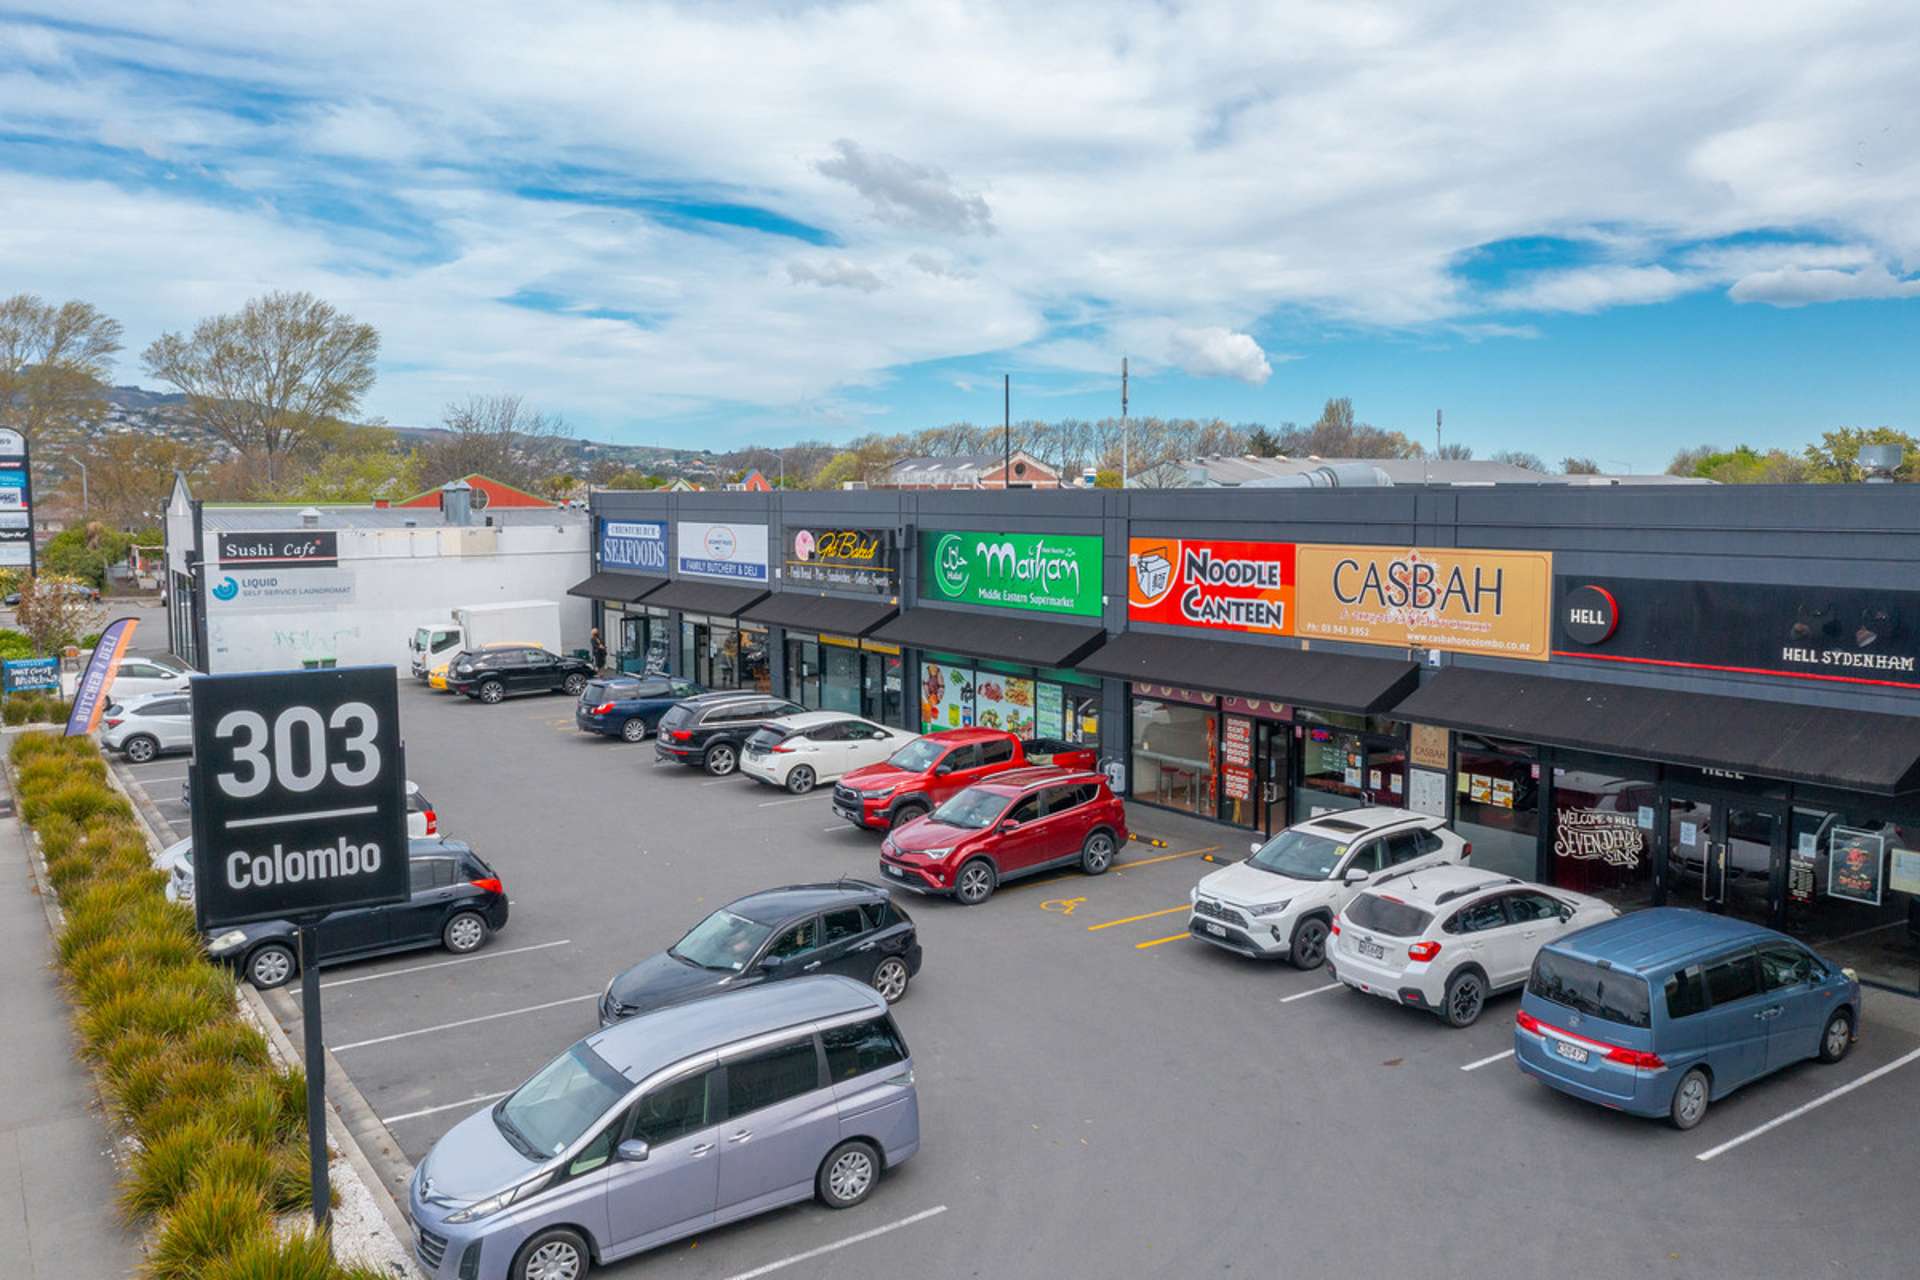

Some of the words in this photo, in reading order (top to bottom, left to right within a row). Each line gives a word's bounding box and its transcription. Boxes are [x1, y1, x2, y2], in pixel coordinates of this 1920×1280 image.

[226, 543, 275, 557] Sushi
[604, 539, 665, 567] SEAFOODS
[839, 531, 879, 560] Baked
[707, 561, 736, 574] BUTCHERY
[738, 563, 744, 575] &
[744, 564, 758, 577] DELI
[242, 577, 278, 589] LIQUID
[243, 590, 260, 598] SELF
[263, 589, 297, 597] SERVICE
[299, 586, 351, 596] LAUNDROMAT
[1333, 558, 1503, 616] CASBAH
[978, 587, 1001, 600] Middle
[1003, 589, 1028, 603] Eastern
[1029, 592, 1074, 608] Supermarket
[1570, 608, 1606, 625] HELL
[1782, 646, 1819, 665] HELL
[1821, 649, 1915, 672] SYDENHAM
[76, 671, 105, 724] BUTCHER
[100, 634, 118, 659] DELI
[215, 701, 381, 798] 303
[1415, 746, 1446, 760] CASBAH
[1557, 808, 1606, 825] WELCOME
[1615, 815, 1637, 827] HELL
[1554, 825, 1602, 857] SEVEN
[226, 836, 382, 890] Colombo
[1603, 847, 1640, 865] SINS
